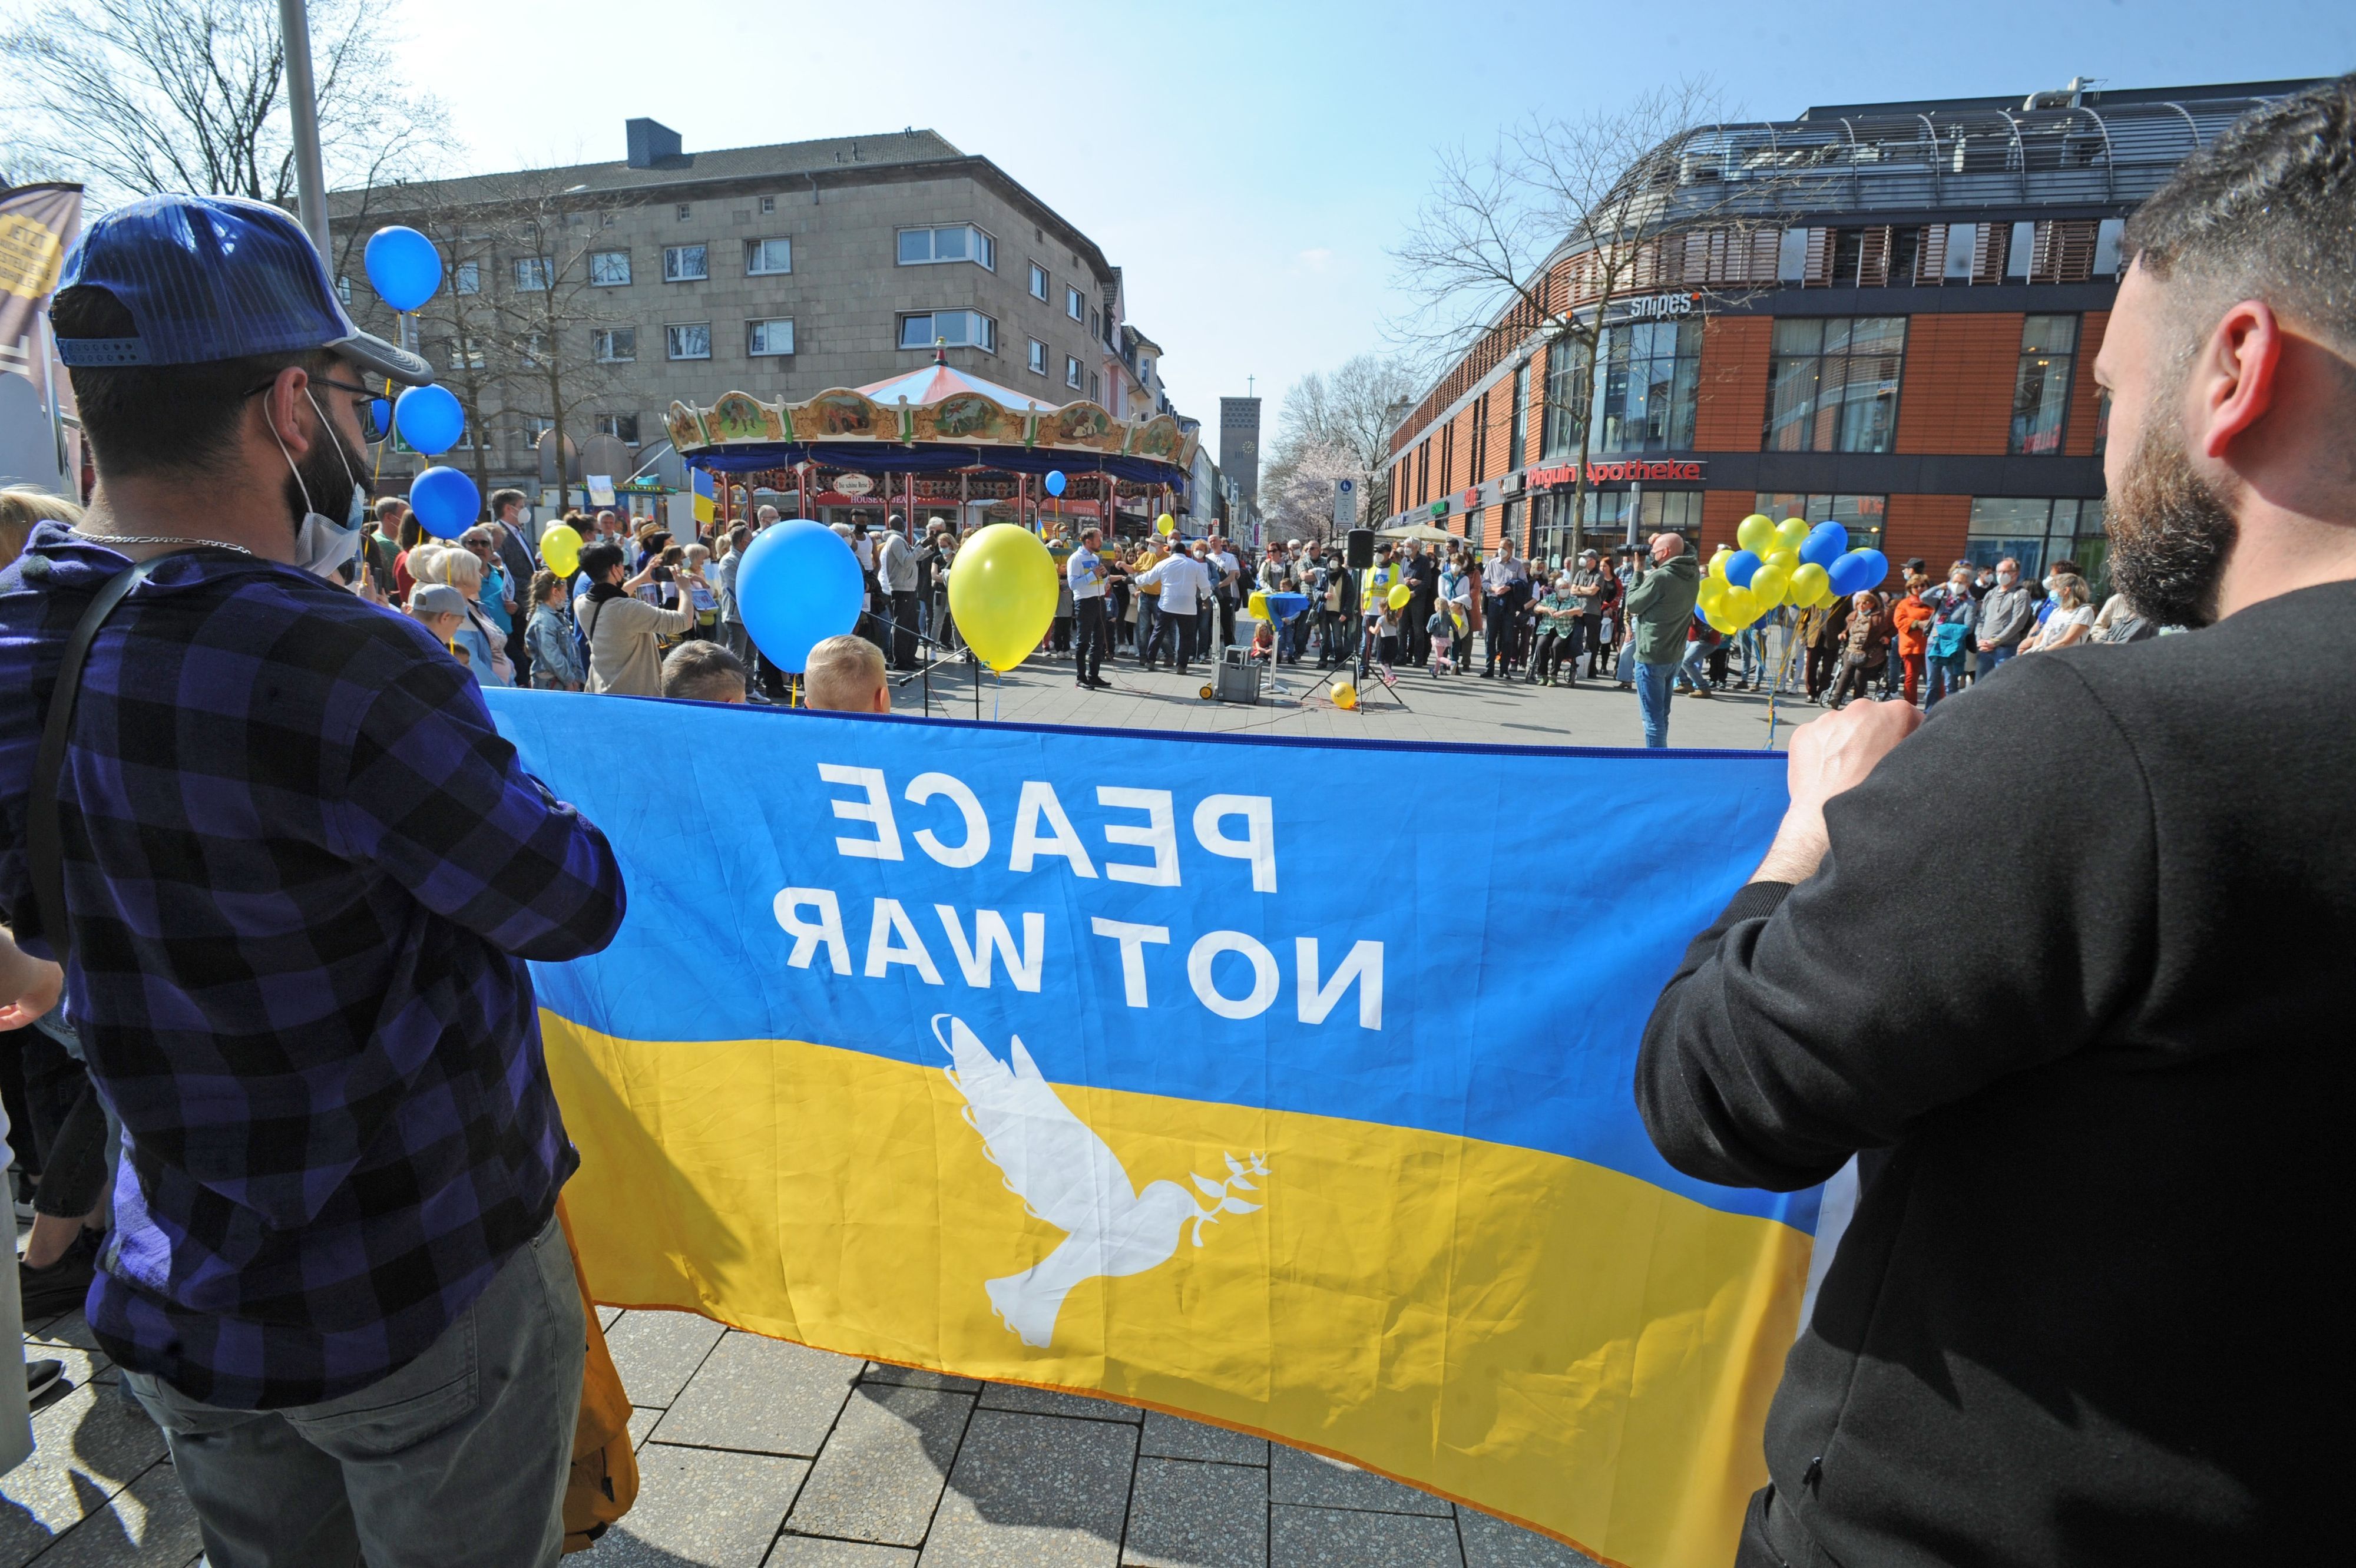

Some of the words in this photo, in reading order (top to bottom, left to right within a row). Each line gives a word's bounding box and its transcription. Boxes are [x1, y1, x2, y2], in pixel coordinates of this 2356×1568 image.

[6, 223, 47, 250] JETZT
[1631, 294, 1692, 319] snipes
[1531, 462, 1576, 489] Pinguin
